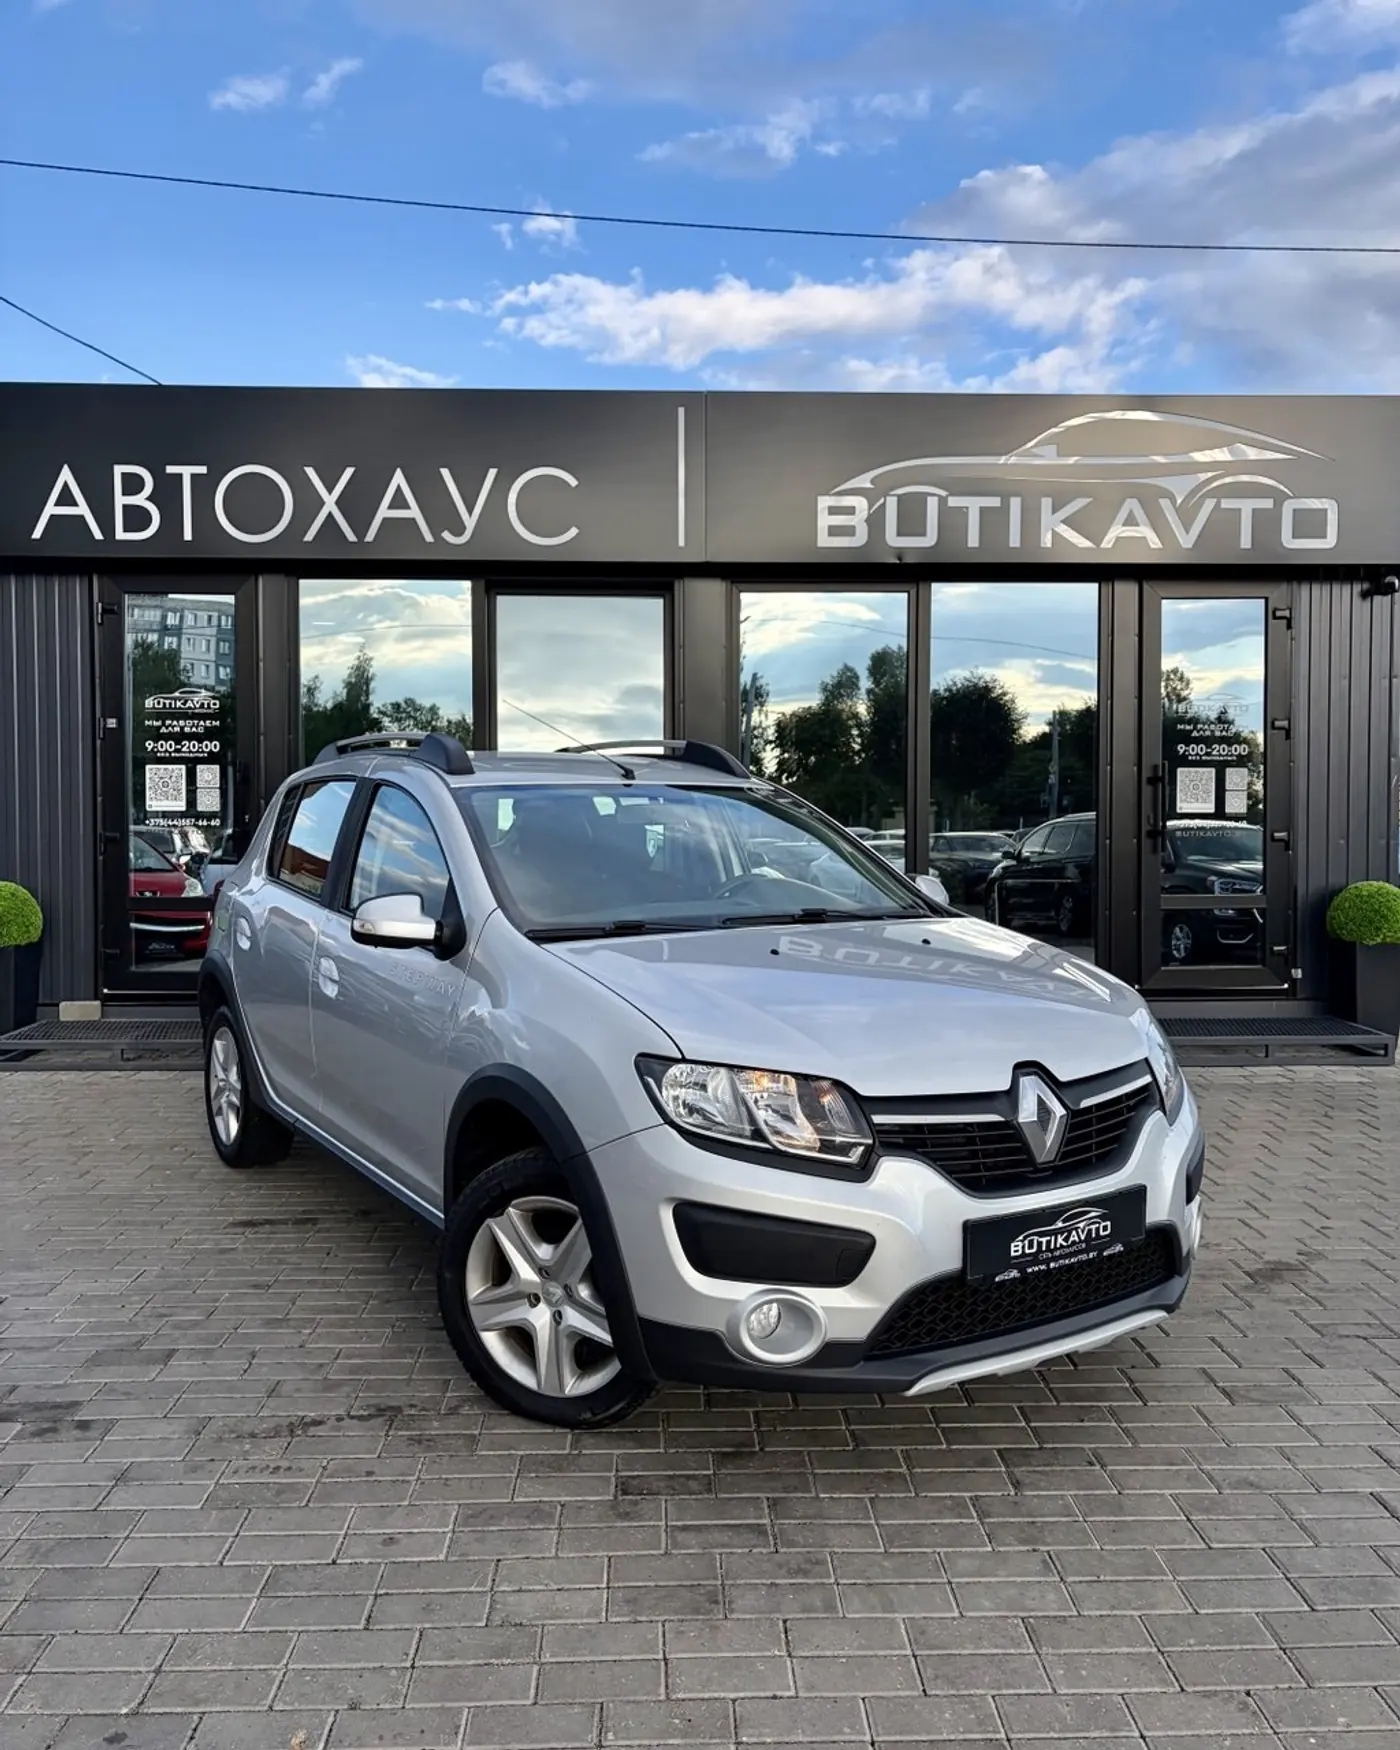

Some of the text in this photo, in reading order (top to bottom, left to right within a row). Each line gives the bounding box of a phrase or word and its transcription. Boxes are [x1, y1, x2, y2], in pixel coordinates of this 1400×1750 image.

[31, 463, 580, 545] АВТОХАУС
[816, 494, 1339, 550] BUTIKAVTO
[144, 699, 220, 709] BUTIKAVTO
[165, 720, 220, 728] РАБОТАЕМ
[145, 740, 220, 752] 9:00-20:00
[1177, 744, 1249, 755] 9:00-20:00
[1010, 1220, 1111, 1257] BUTIKAVTO
